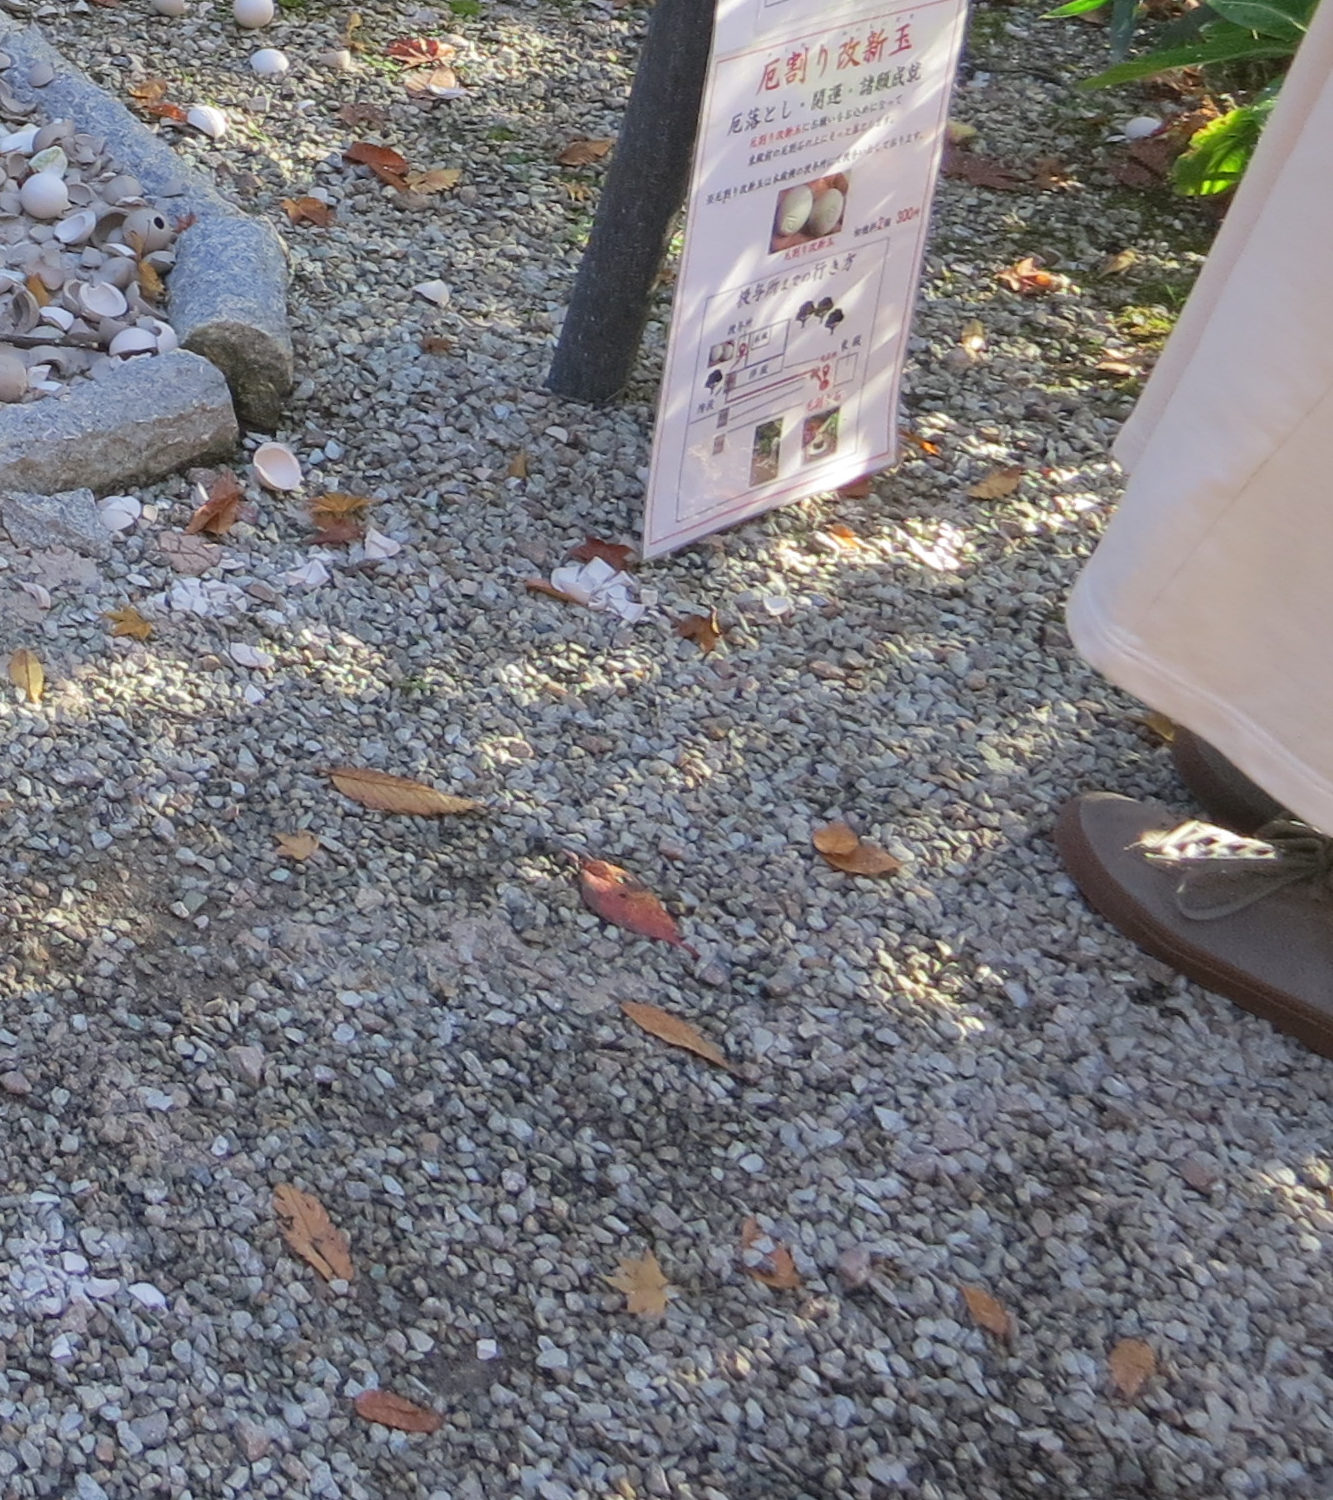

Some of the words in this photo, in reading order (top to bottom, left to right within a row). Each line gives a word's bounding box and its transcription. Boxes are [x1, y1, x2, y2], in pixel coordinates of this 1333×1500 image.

[756, 24, 913, 93] 厄割り改新玉
